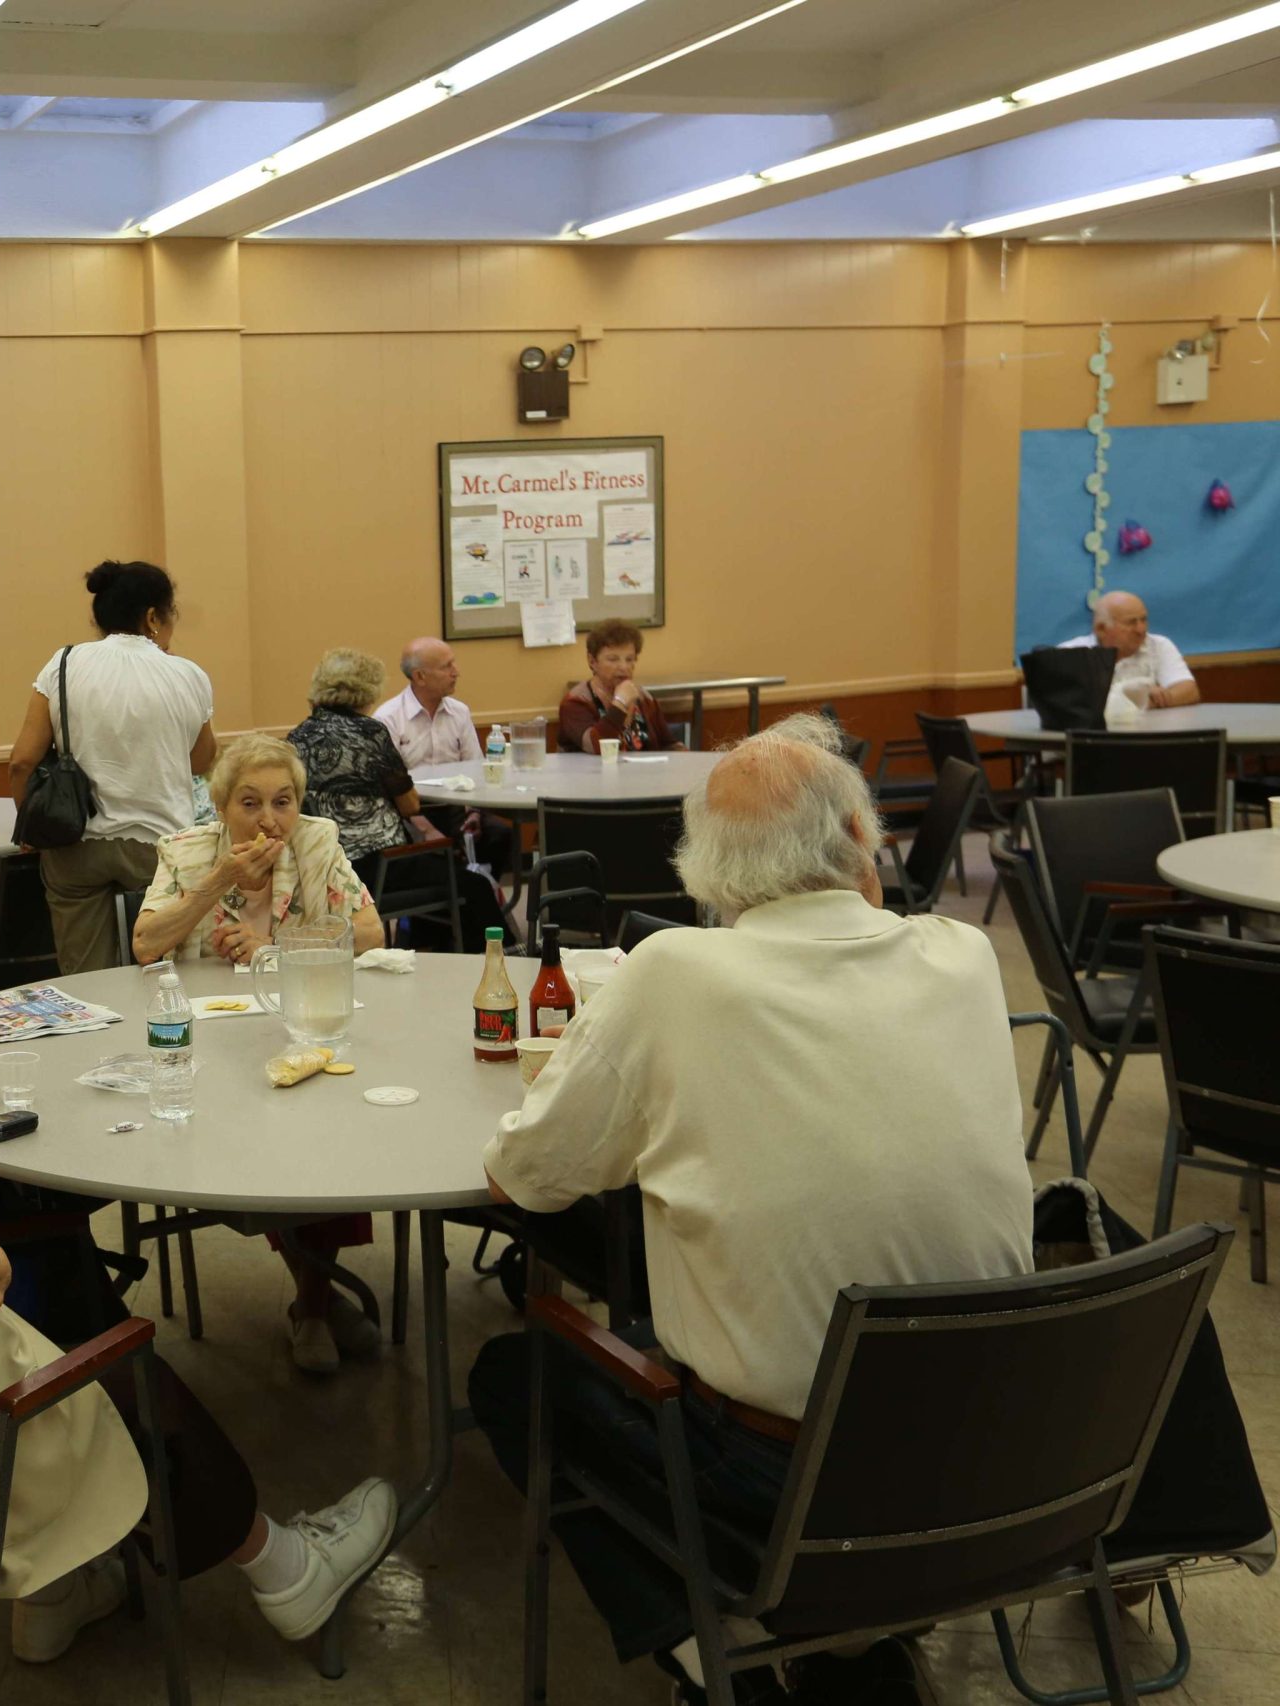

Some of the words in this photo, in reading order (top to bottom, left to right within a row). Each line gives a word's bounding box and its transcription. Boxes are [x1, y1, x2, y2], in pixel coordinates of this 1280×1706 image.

[498, 469, 577, 493] Carmel's
[582, 470, 645, 491] Fitness
[502, 510, 583, 533] Program
[40, 988, 66, 1003] RITE
[61, 1000, 87, 1012] AID
